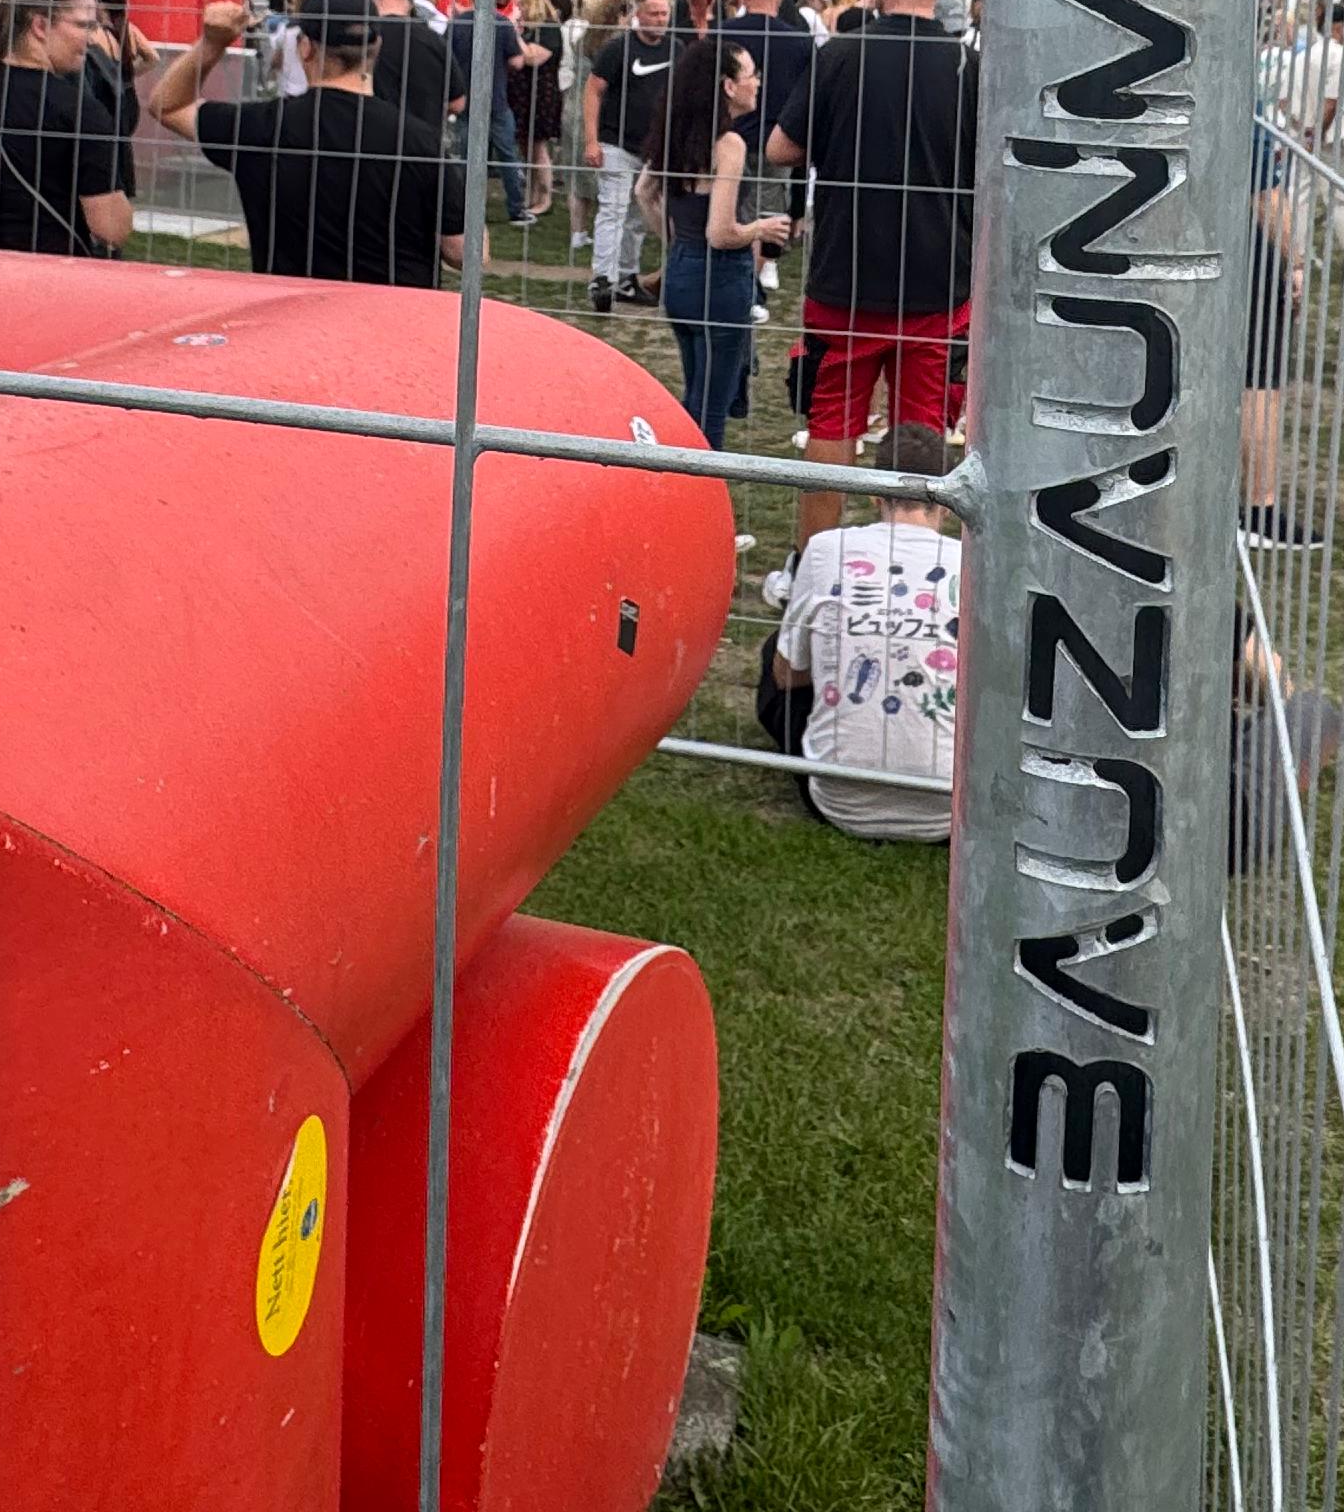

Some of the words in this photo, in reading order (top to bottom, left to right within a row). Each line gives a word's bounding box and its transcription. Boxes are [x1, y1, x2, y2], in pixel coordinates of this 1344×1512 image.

[846, 612, 941, 638] ビュッフェ
